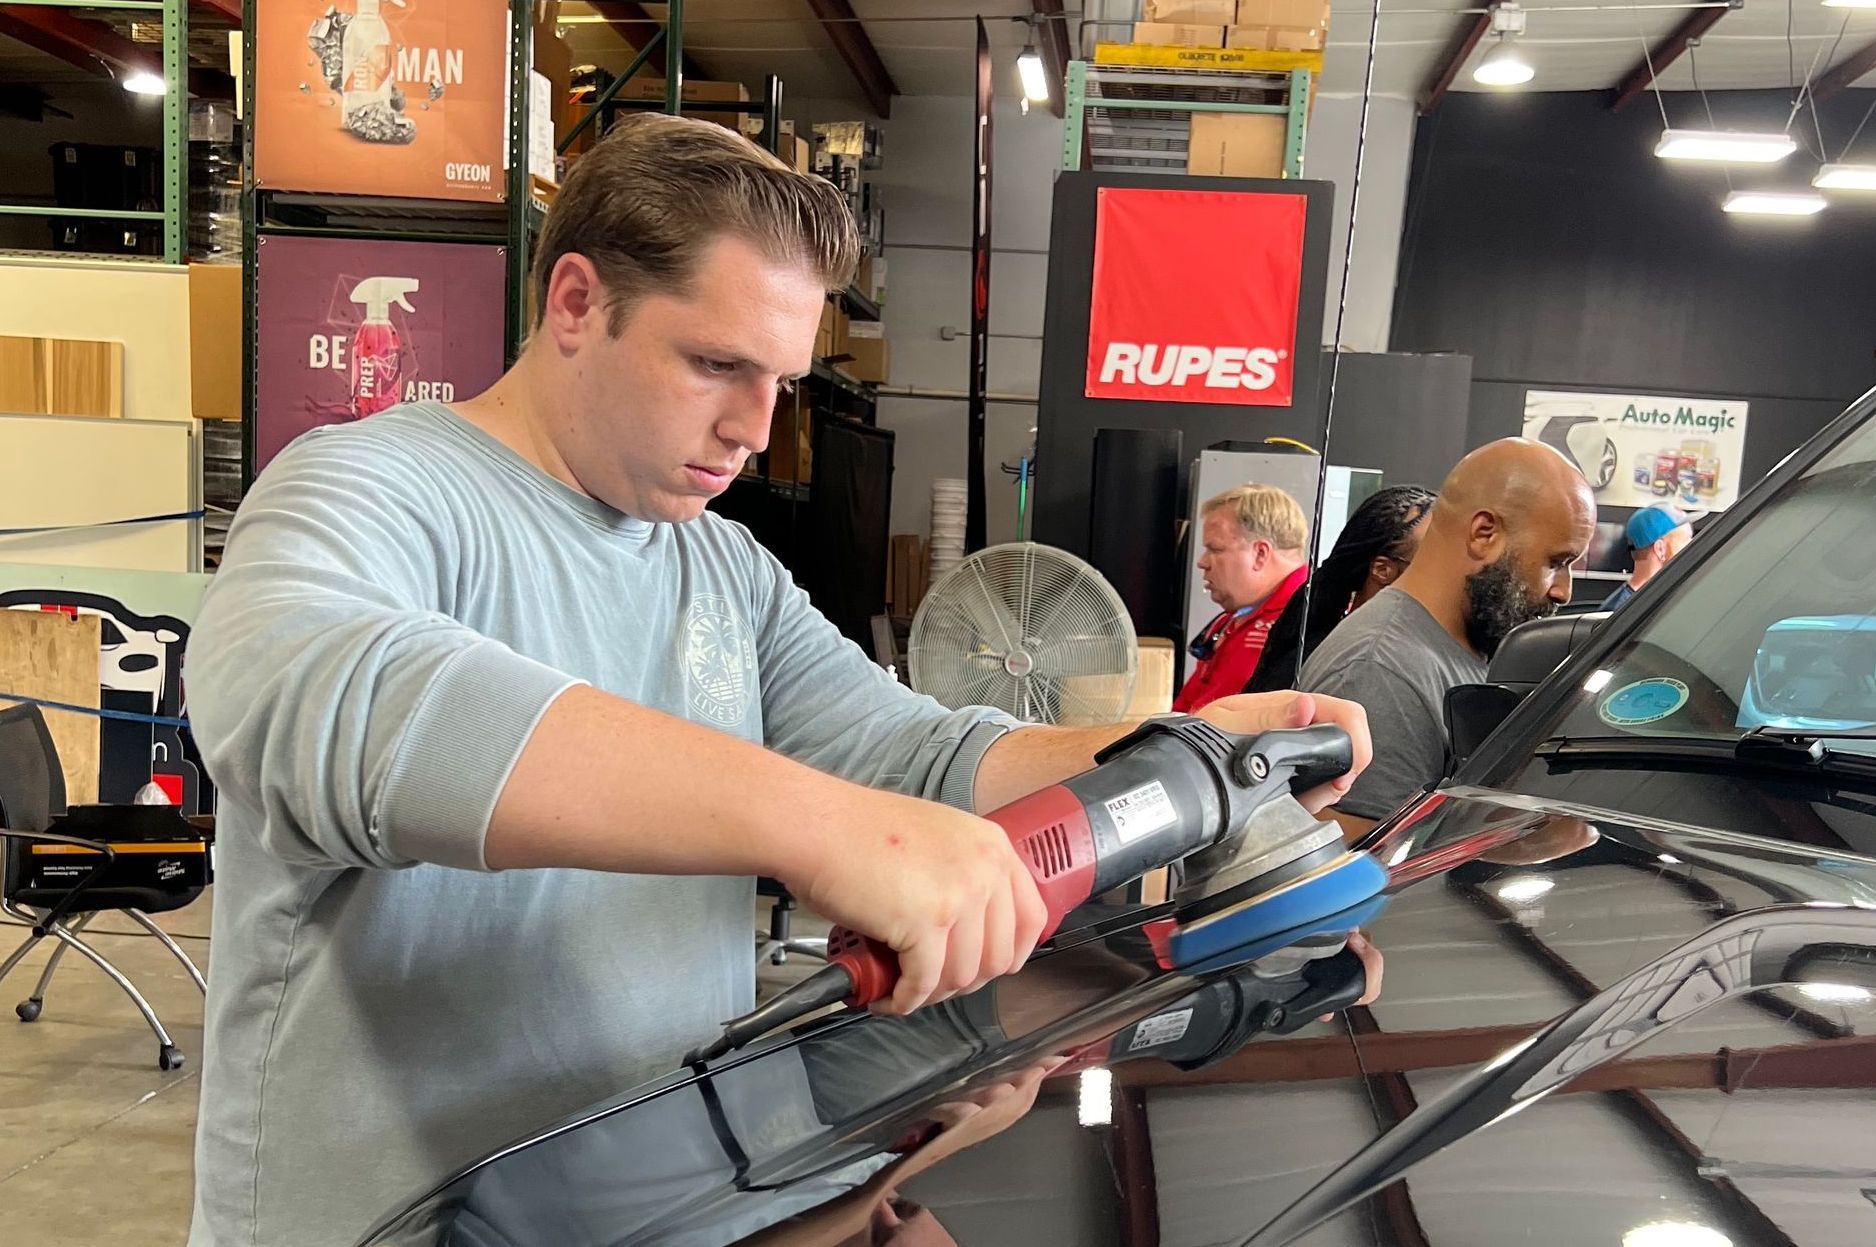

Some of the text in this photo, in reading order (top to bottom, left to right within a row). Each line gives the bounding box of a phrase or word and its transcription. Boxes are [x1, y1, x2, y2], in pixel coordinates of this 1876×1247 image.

[397, 47, 464, 84] MAN
[445, 162, 491, 182] GYEON
[309, 334, 347, 369] BE
[1099, 342, 1279, 390] RUPES
[360, 356, 374, 398] PREP
[404, 380, 455, 403] ARED
[1622, 404, 1670, 424] Auto
[1674, 407, 1735, 433] Magic
[1108, 797, 1130, 812] FLEX
